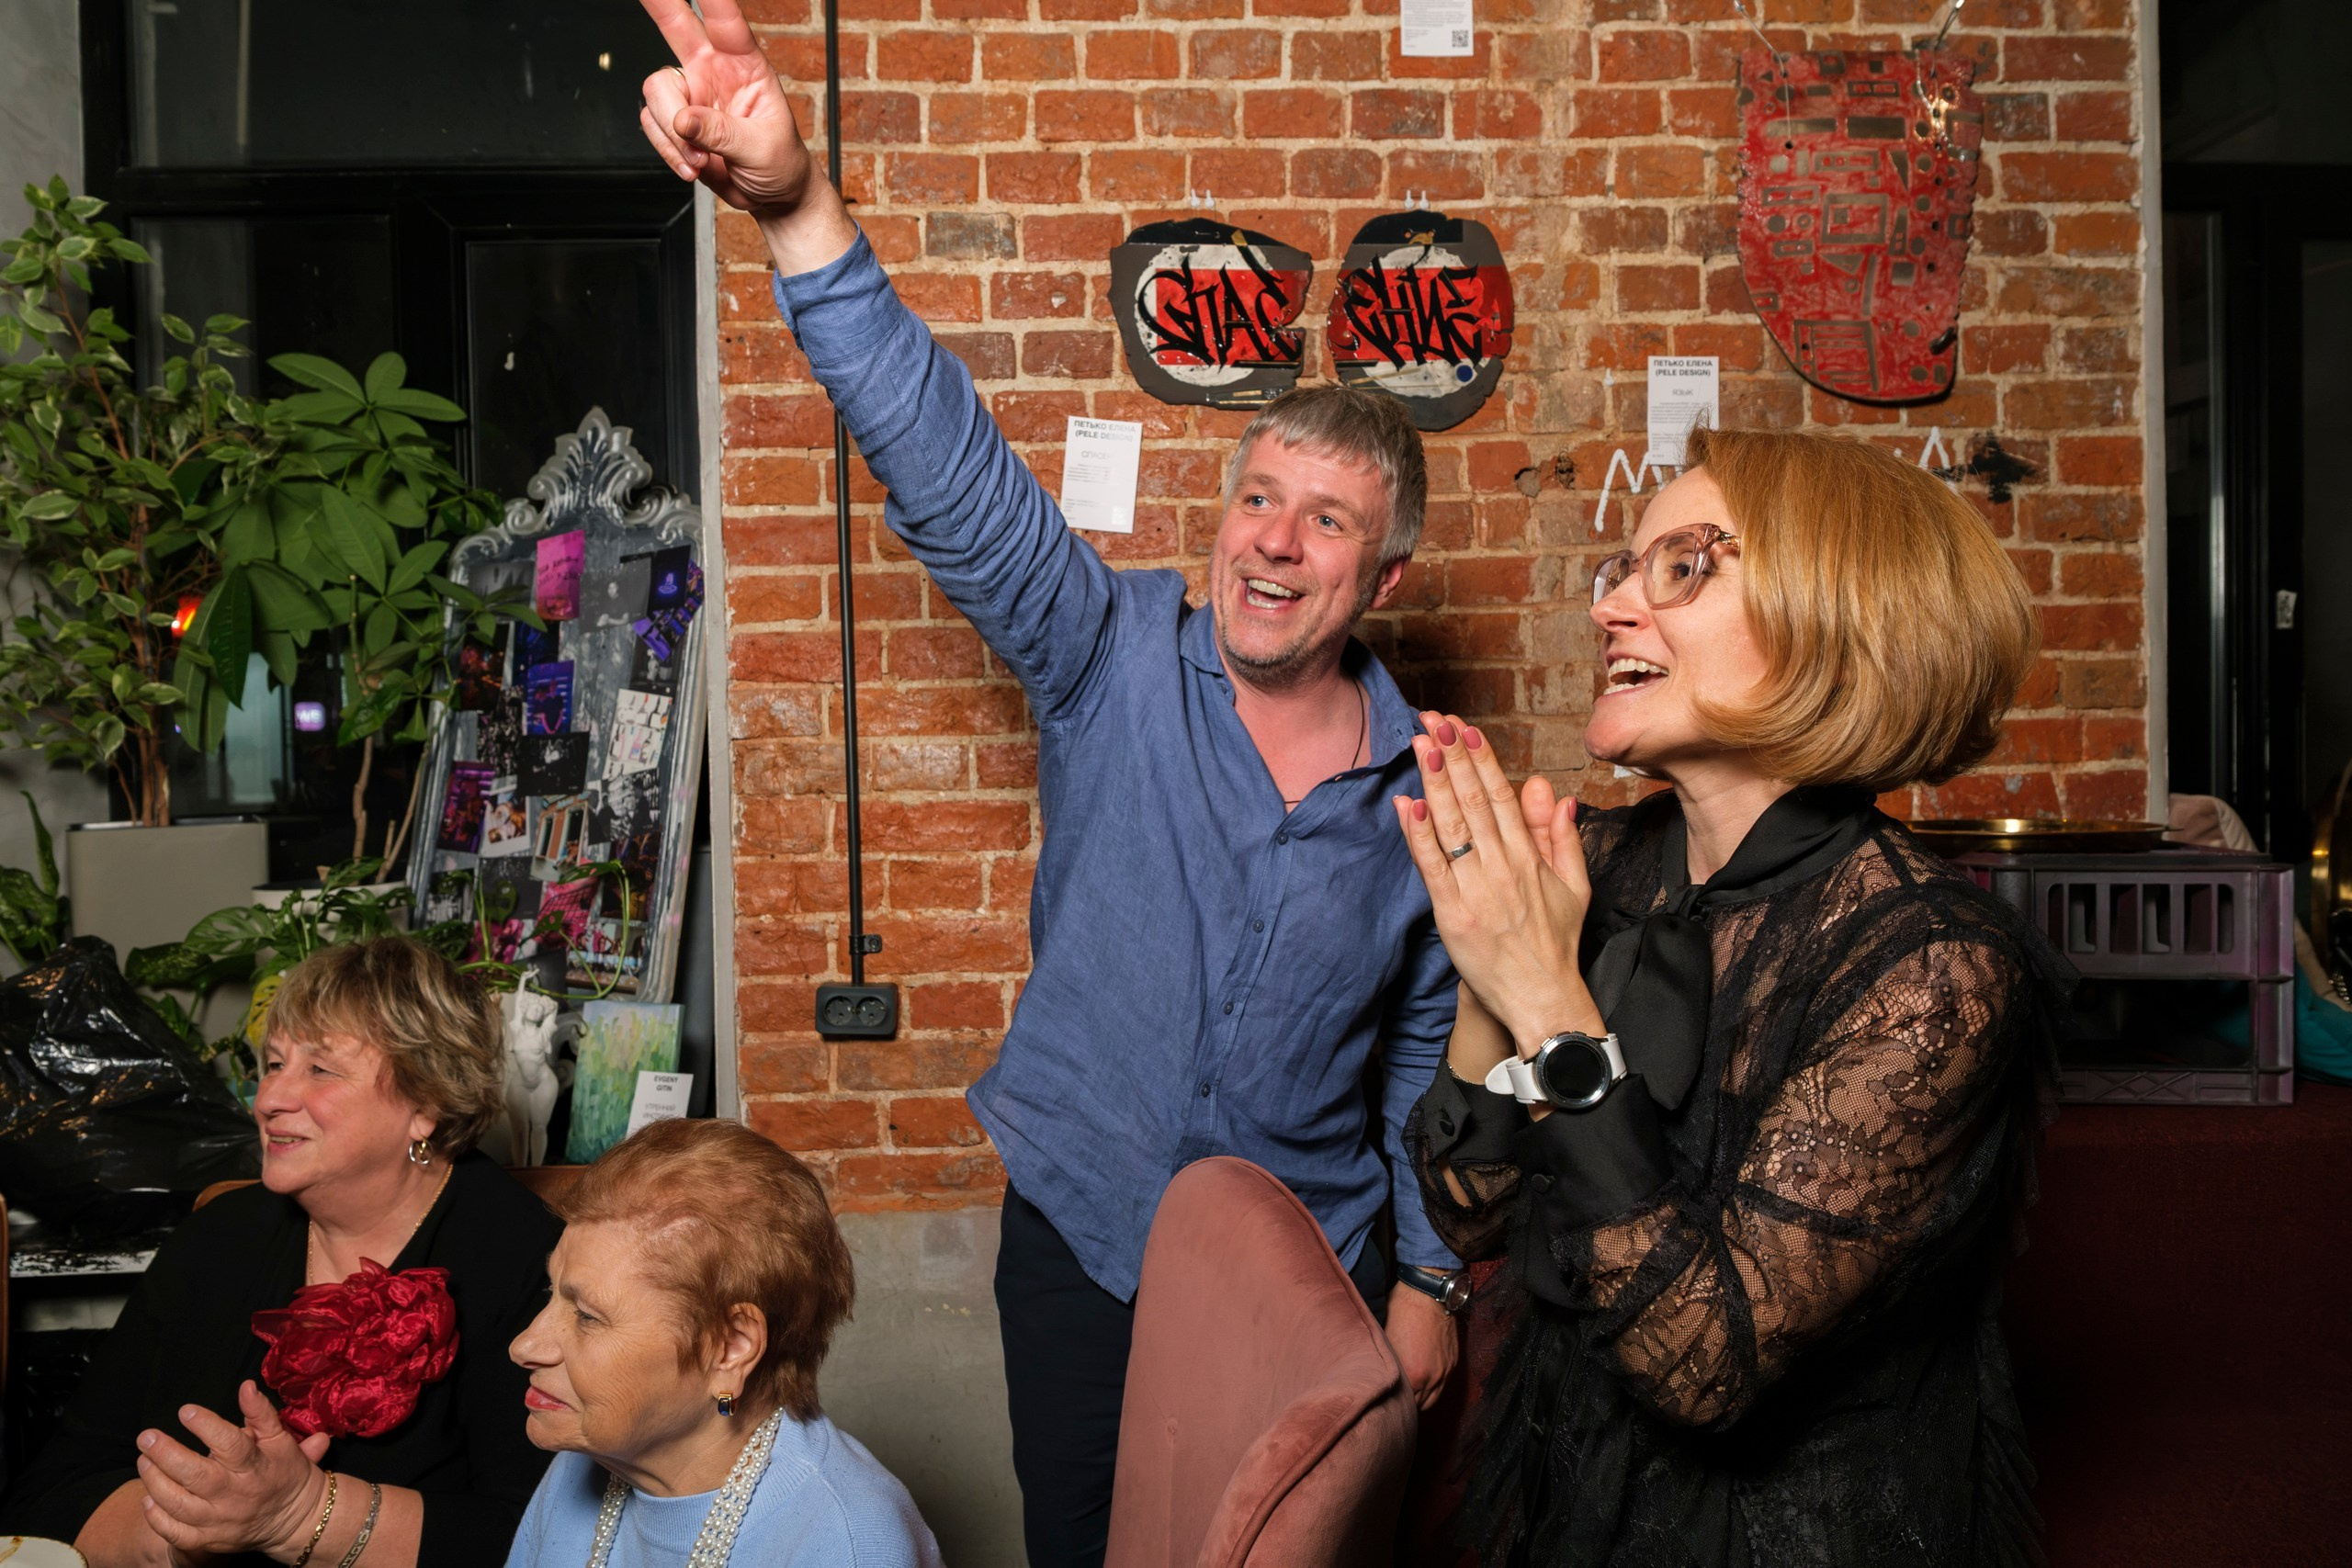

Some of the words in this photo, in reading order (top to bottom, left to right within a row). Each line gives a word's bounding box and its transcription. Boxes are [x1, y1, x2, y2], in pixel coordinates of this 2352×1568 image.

[1074, 420, 1107, 430] ПЕТЬКО
[1075, 430, 1099, 439] (PELE
[654, 1075, 679, 1083] EVGENY
